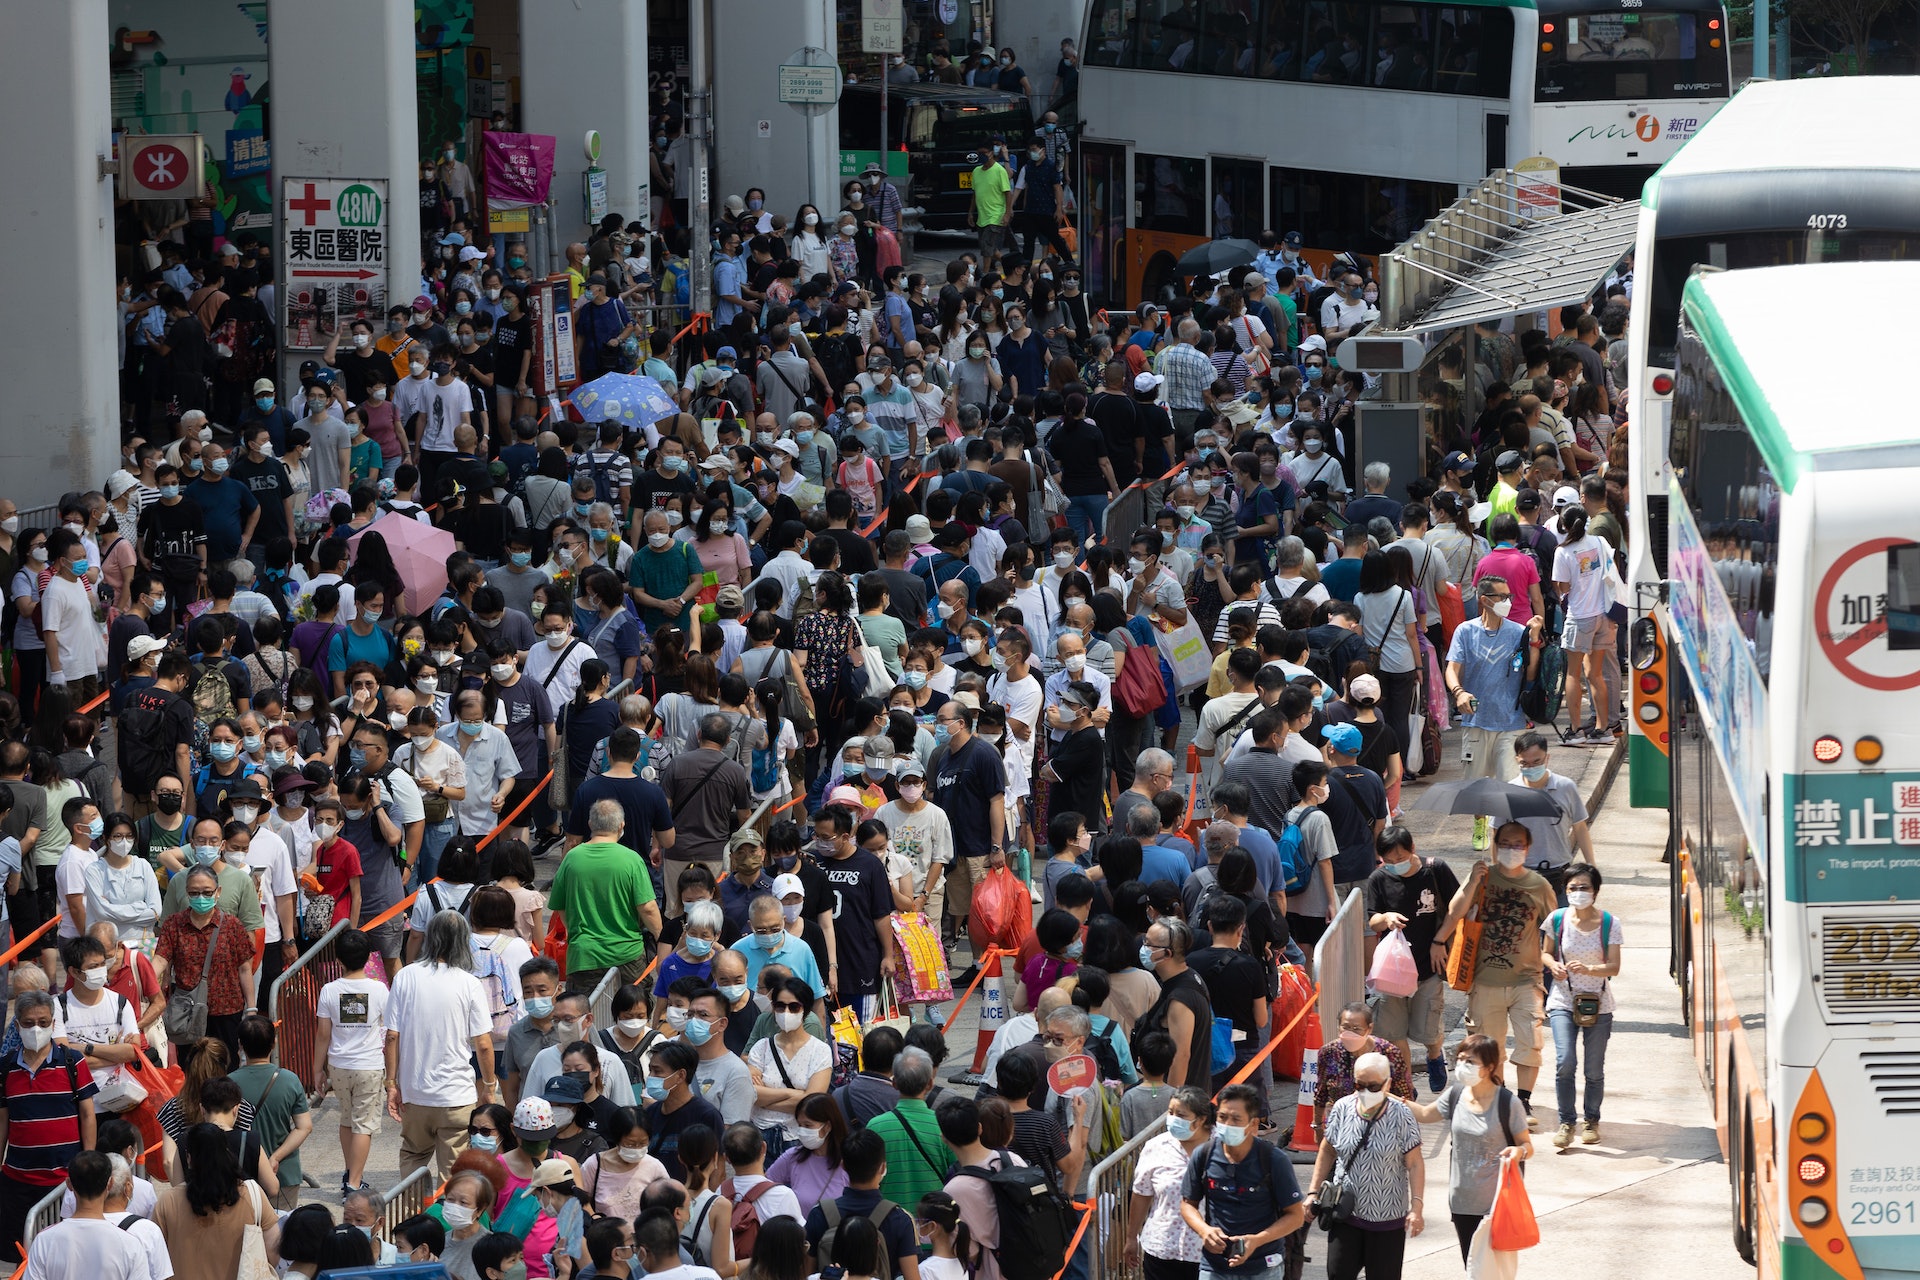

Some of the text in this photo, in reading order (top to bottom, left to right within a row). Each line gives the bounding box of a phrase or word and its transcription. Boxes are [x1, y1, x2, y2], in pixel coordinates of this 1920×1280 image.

[873, 23, 891, 31] End
[869, 36, 895, 49] 終止
[1668, 118, 1698, 132] 新巴
[842, 165, 856, 173] BIN
[340, 192, 377, 224] 48M
[1807, 214, 1848, 229] 4073
[289, 228, 382, 262] 東區醫院
[1820, 629, 1860, 640] Heated
[1901, 786, 1920, 808] 進
[1794, 798, 1892, 846] 禁止
[1900, 818, 1920, 840] 推
[1828, 858, 1849, 869] The
[1851, 858, 1887, 870] import,
[1458, 936, 1475, 984] ICE FIRE
[1849, 1184, 1884, 1194] Enquiry
[1886, 1184, 1903, 1192] and
[1851, 1200, 1914, 1225] 2961
